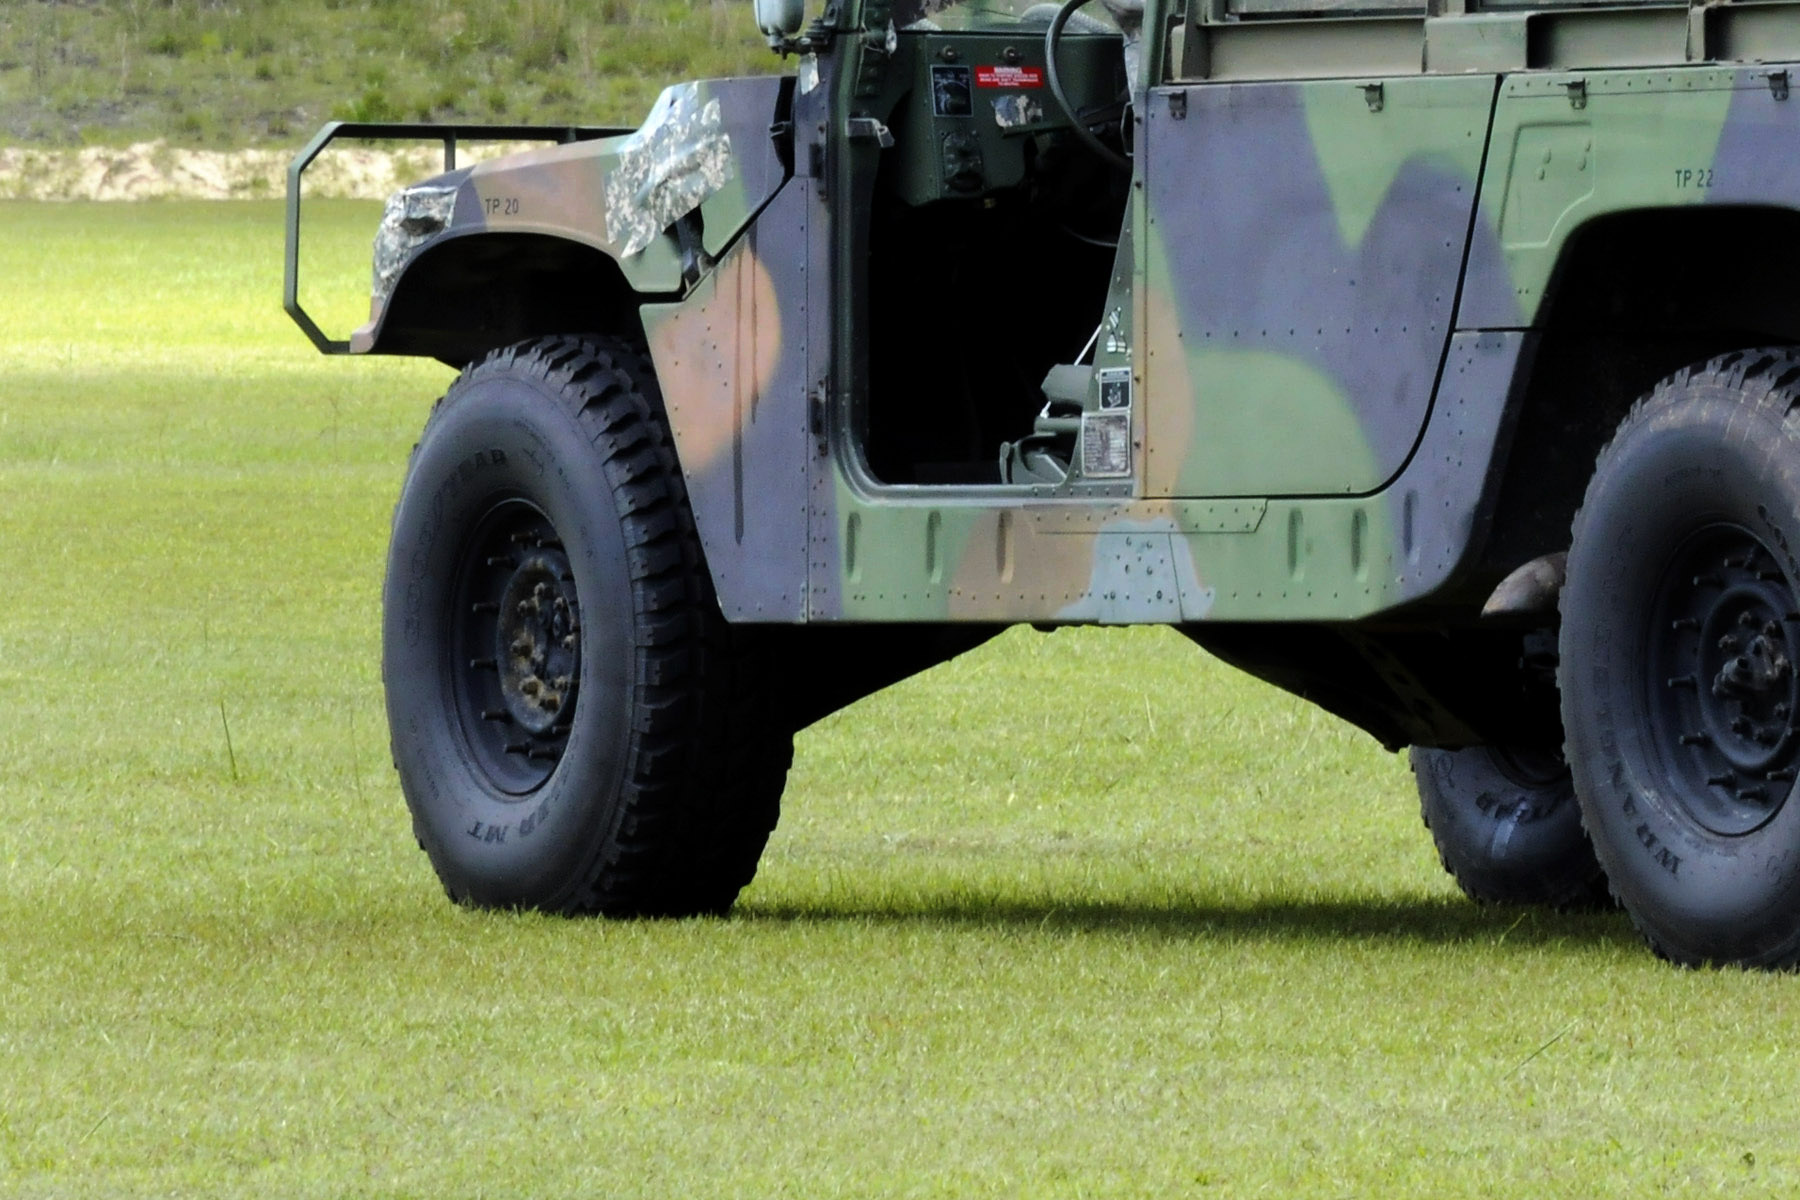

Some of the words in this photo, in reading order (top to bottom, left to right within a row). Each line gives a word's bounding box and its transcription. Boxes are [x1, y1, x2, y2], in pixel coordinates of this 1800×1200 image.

[1675, 169, 1692, 188] TP
[1697, 169, 1713, 188] 22
[485, 199, 500, 215] TP
[504, 198, 519, 215] 20
